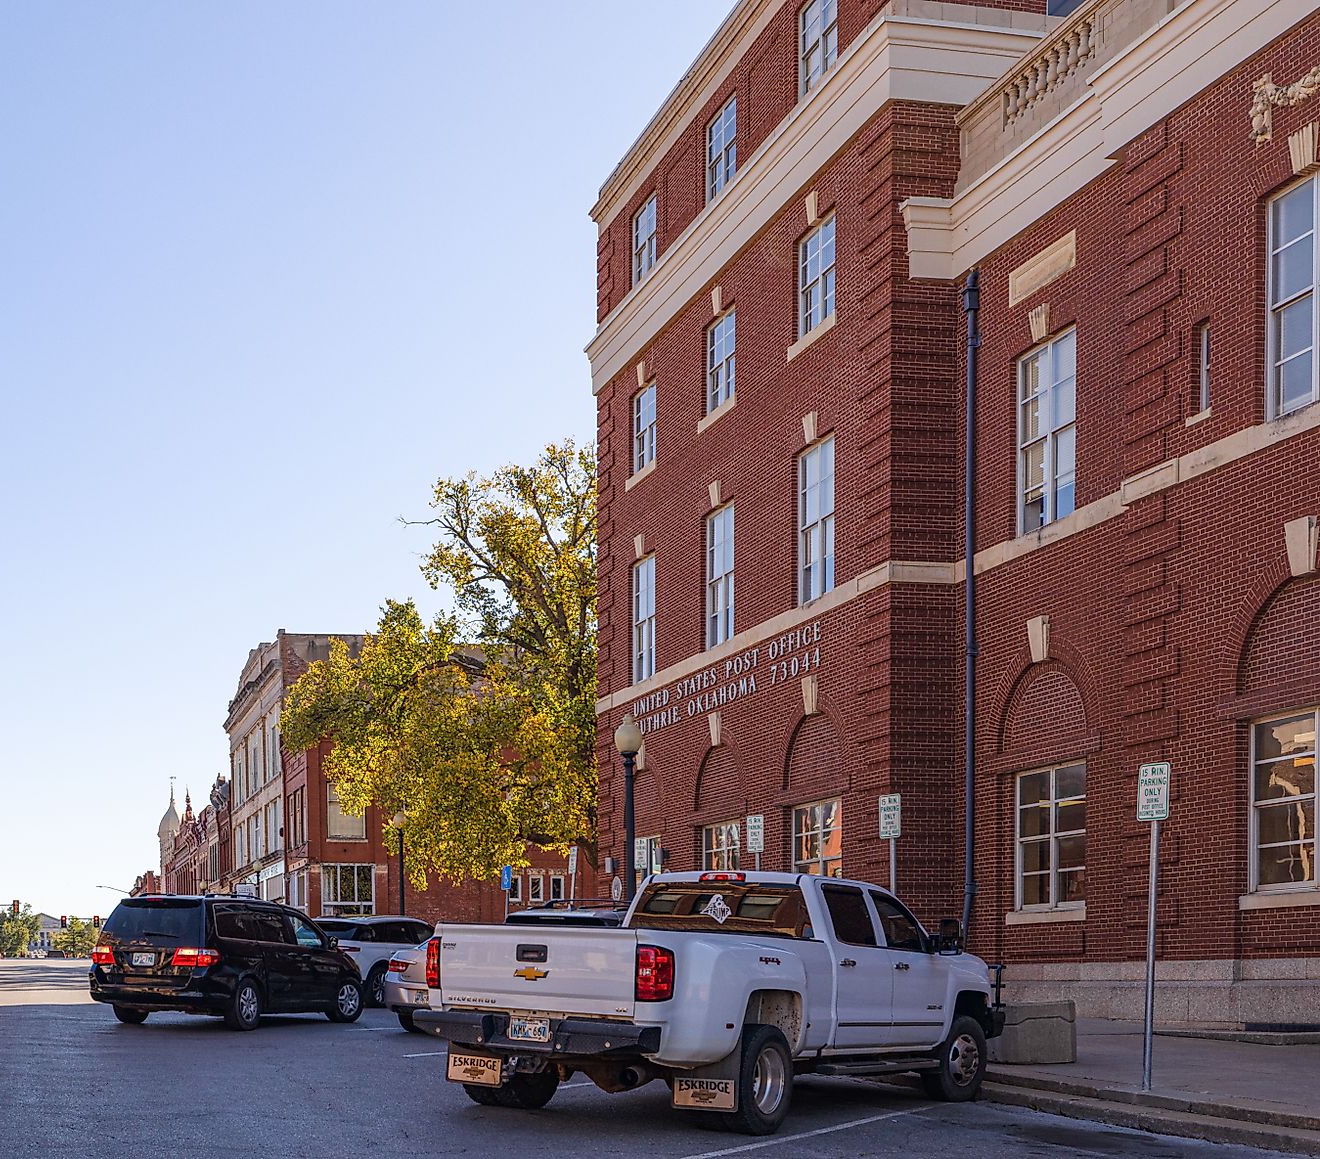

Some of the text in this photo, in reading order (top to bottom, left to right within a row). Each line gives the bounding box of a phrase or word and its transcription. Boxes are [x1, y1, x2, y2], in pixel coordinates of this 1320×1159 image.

[633, 621, 822, 717] UNITED STATES POST OFFICE
[687, 674, 757, 717] OKLAHOMA
[770, 647, 821, 685] 73044
[1142, 769, 1148, 777] 15
[1140, 777, 1167, 787] PARKING
[1144, 787, 1161, 797] ONLY
[453, 1056, 497, 1072] ESKRIDGE
[678, 1079, 731, 1095] ESKRIDGE
